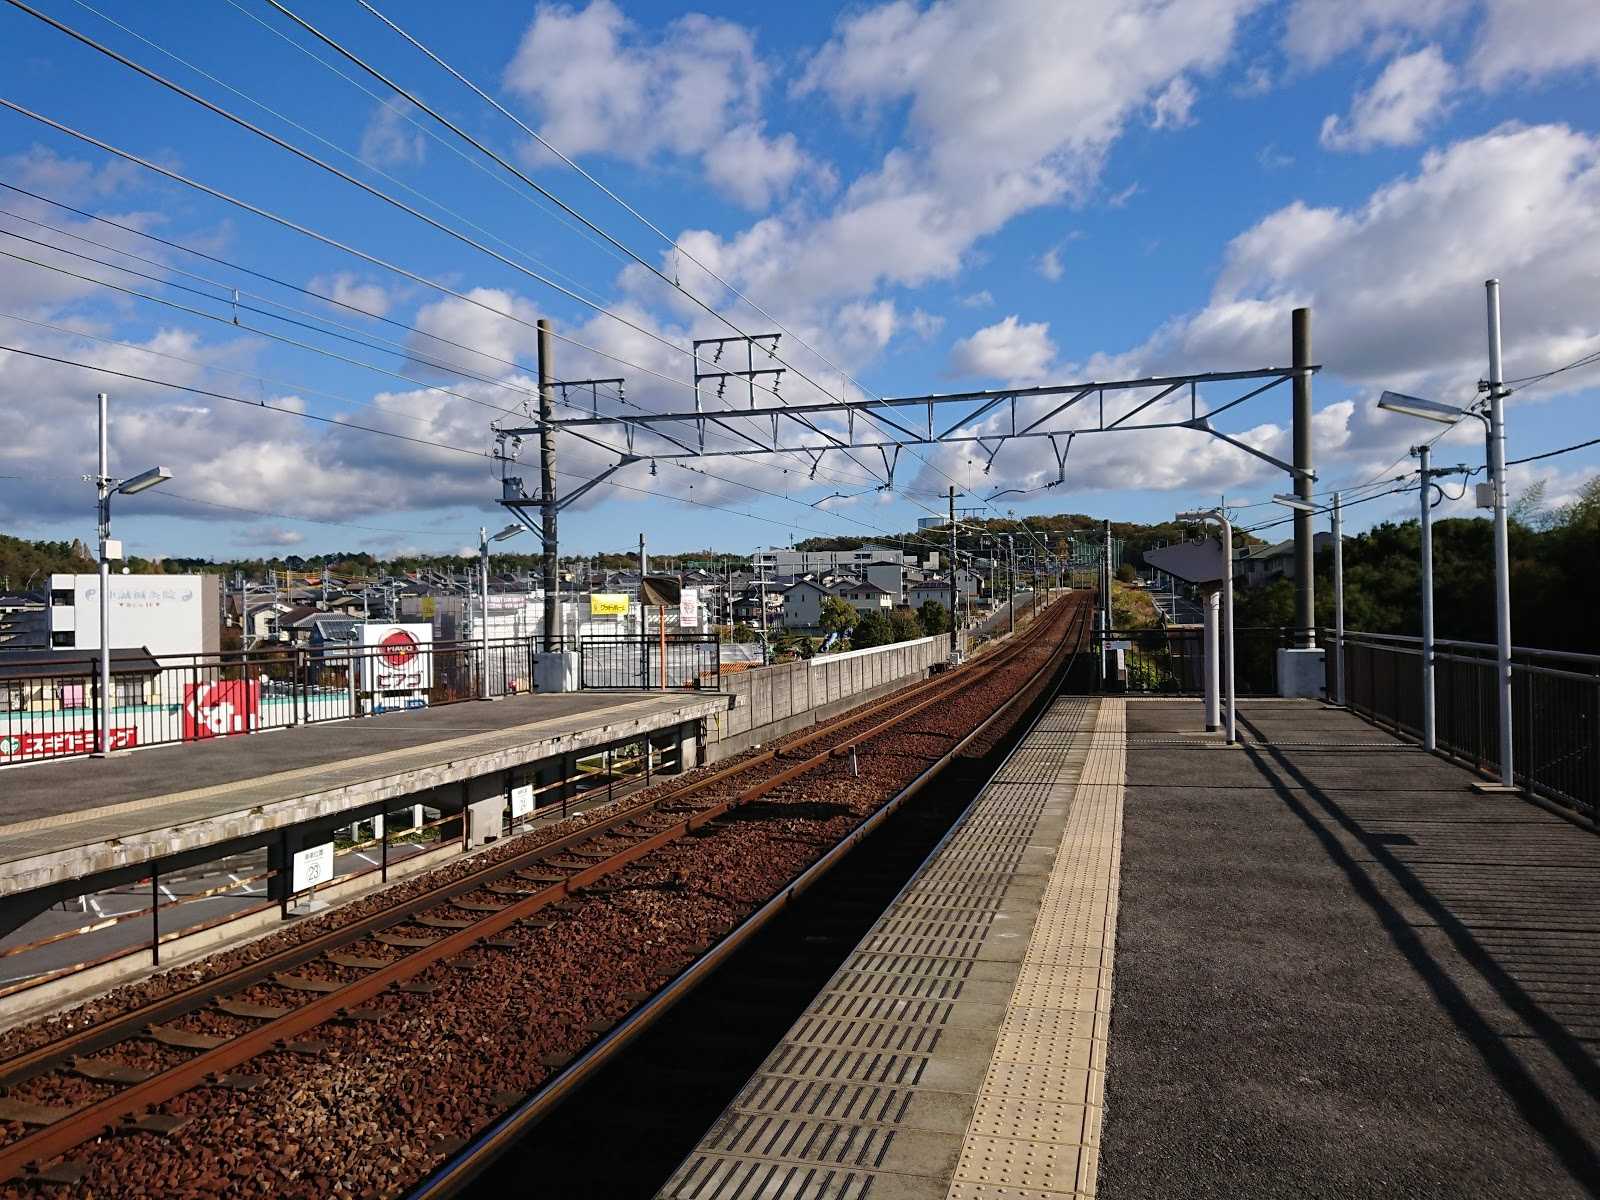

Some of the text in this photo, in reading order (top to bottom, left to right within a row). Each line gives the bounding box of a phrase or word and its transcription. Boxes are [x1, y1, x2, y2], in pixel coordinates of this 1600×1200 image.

[377, 671, 424, 688] ピアゴ
[308, 864, 319, 881] 23
